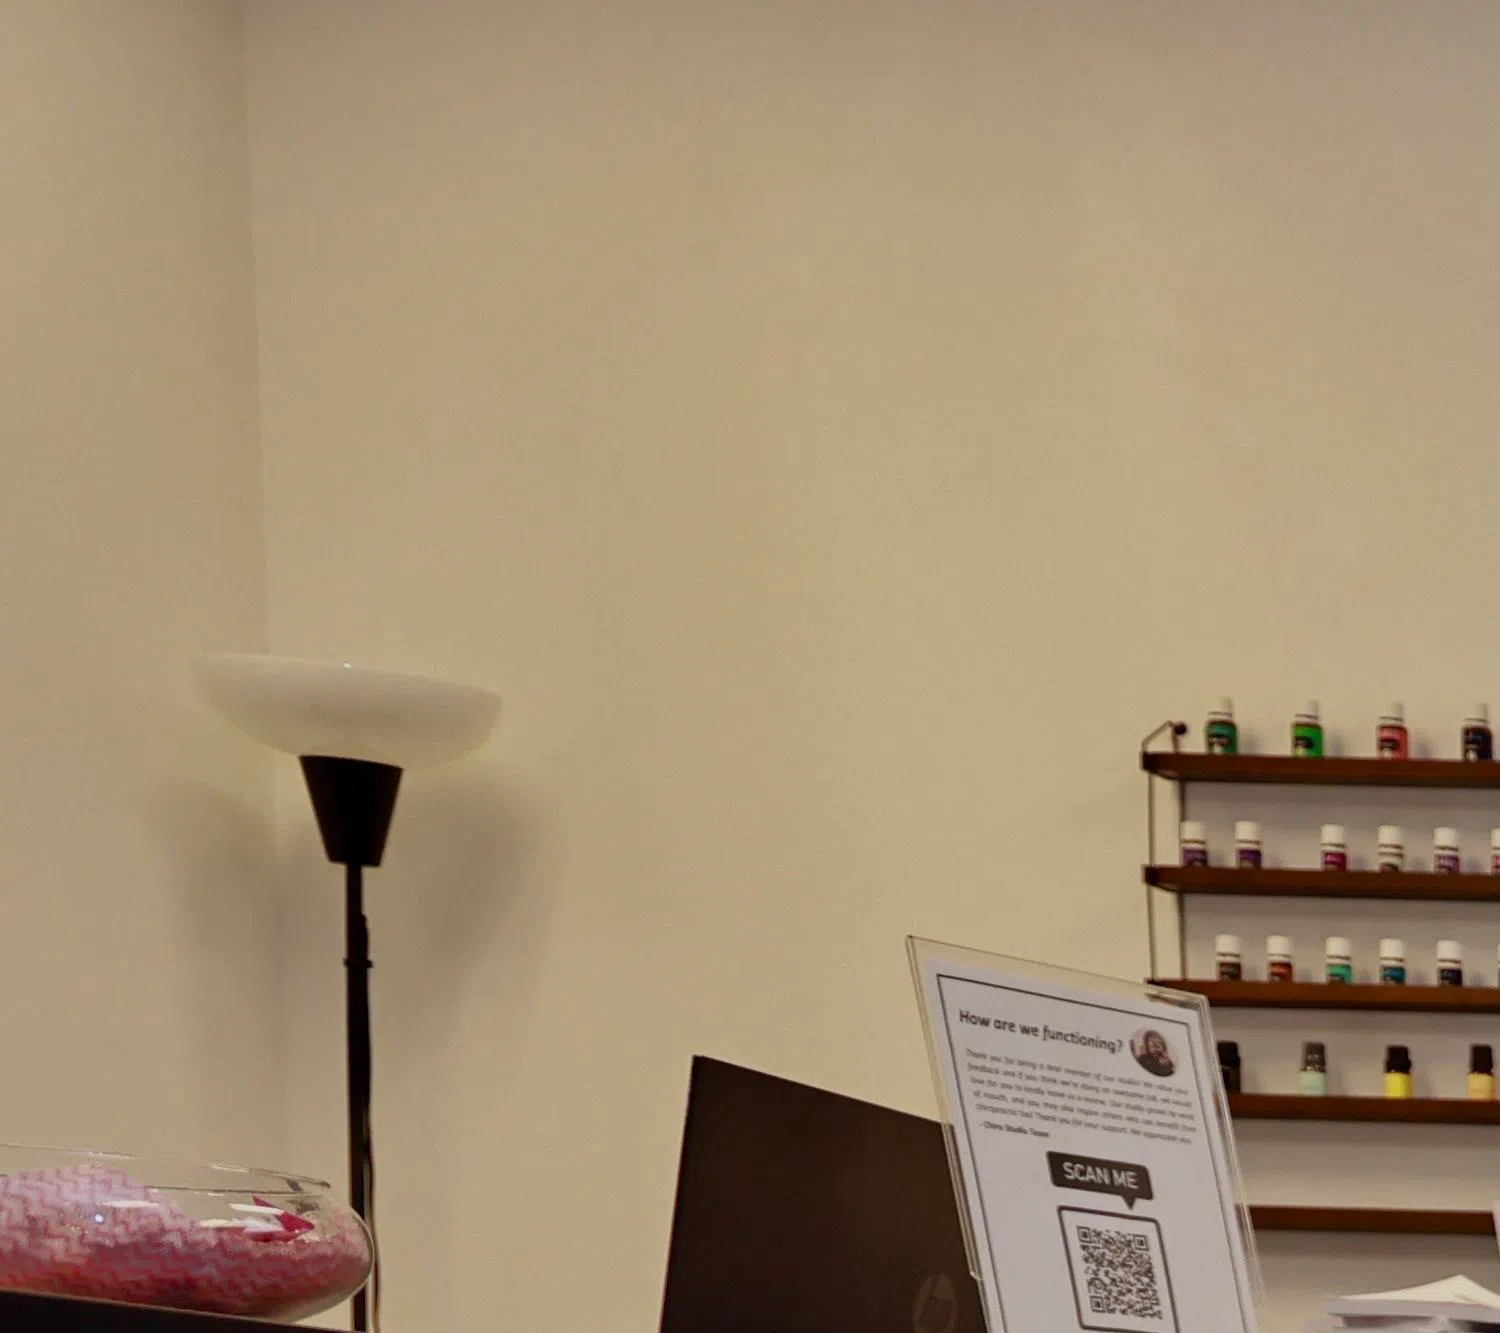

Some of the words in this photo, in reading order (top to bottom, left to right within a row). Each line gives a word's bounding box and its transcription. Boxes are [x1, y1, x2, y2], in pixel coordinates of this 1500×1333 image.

[959, 1010, 990, 1027] How
[993, 1018, 1016, 1032] are
[1019, 1024, 1039, 1037] we
[1042, 1025, 1124, 1054] functioning?
[1062, 1161, 1111, 1185] SCAN
[1111, 1168, 1139, 1189] ME
